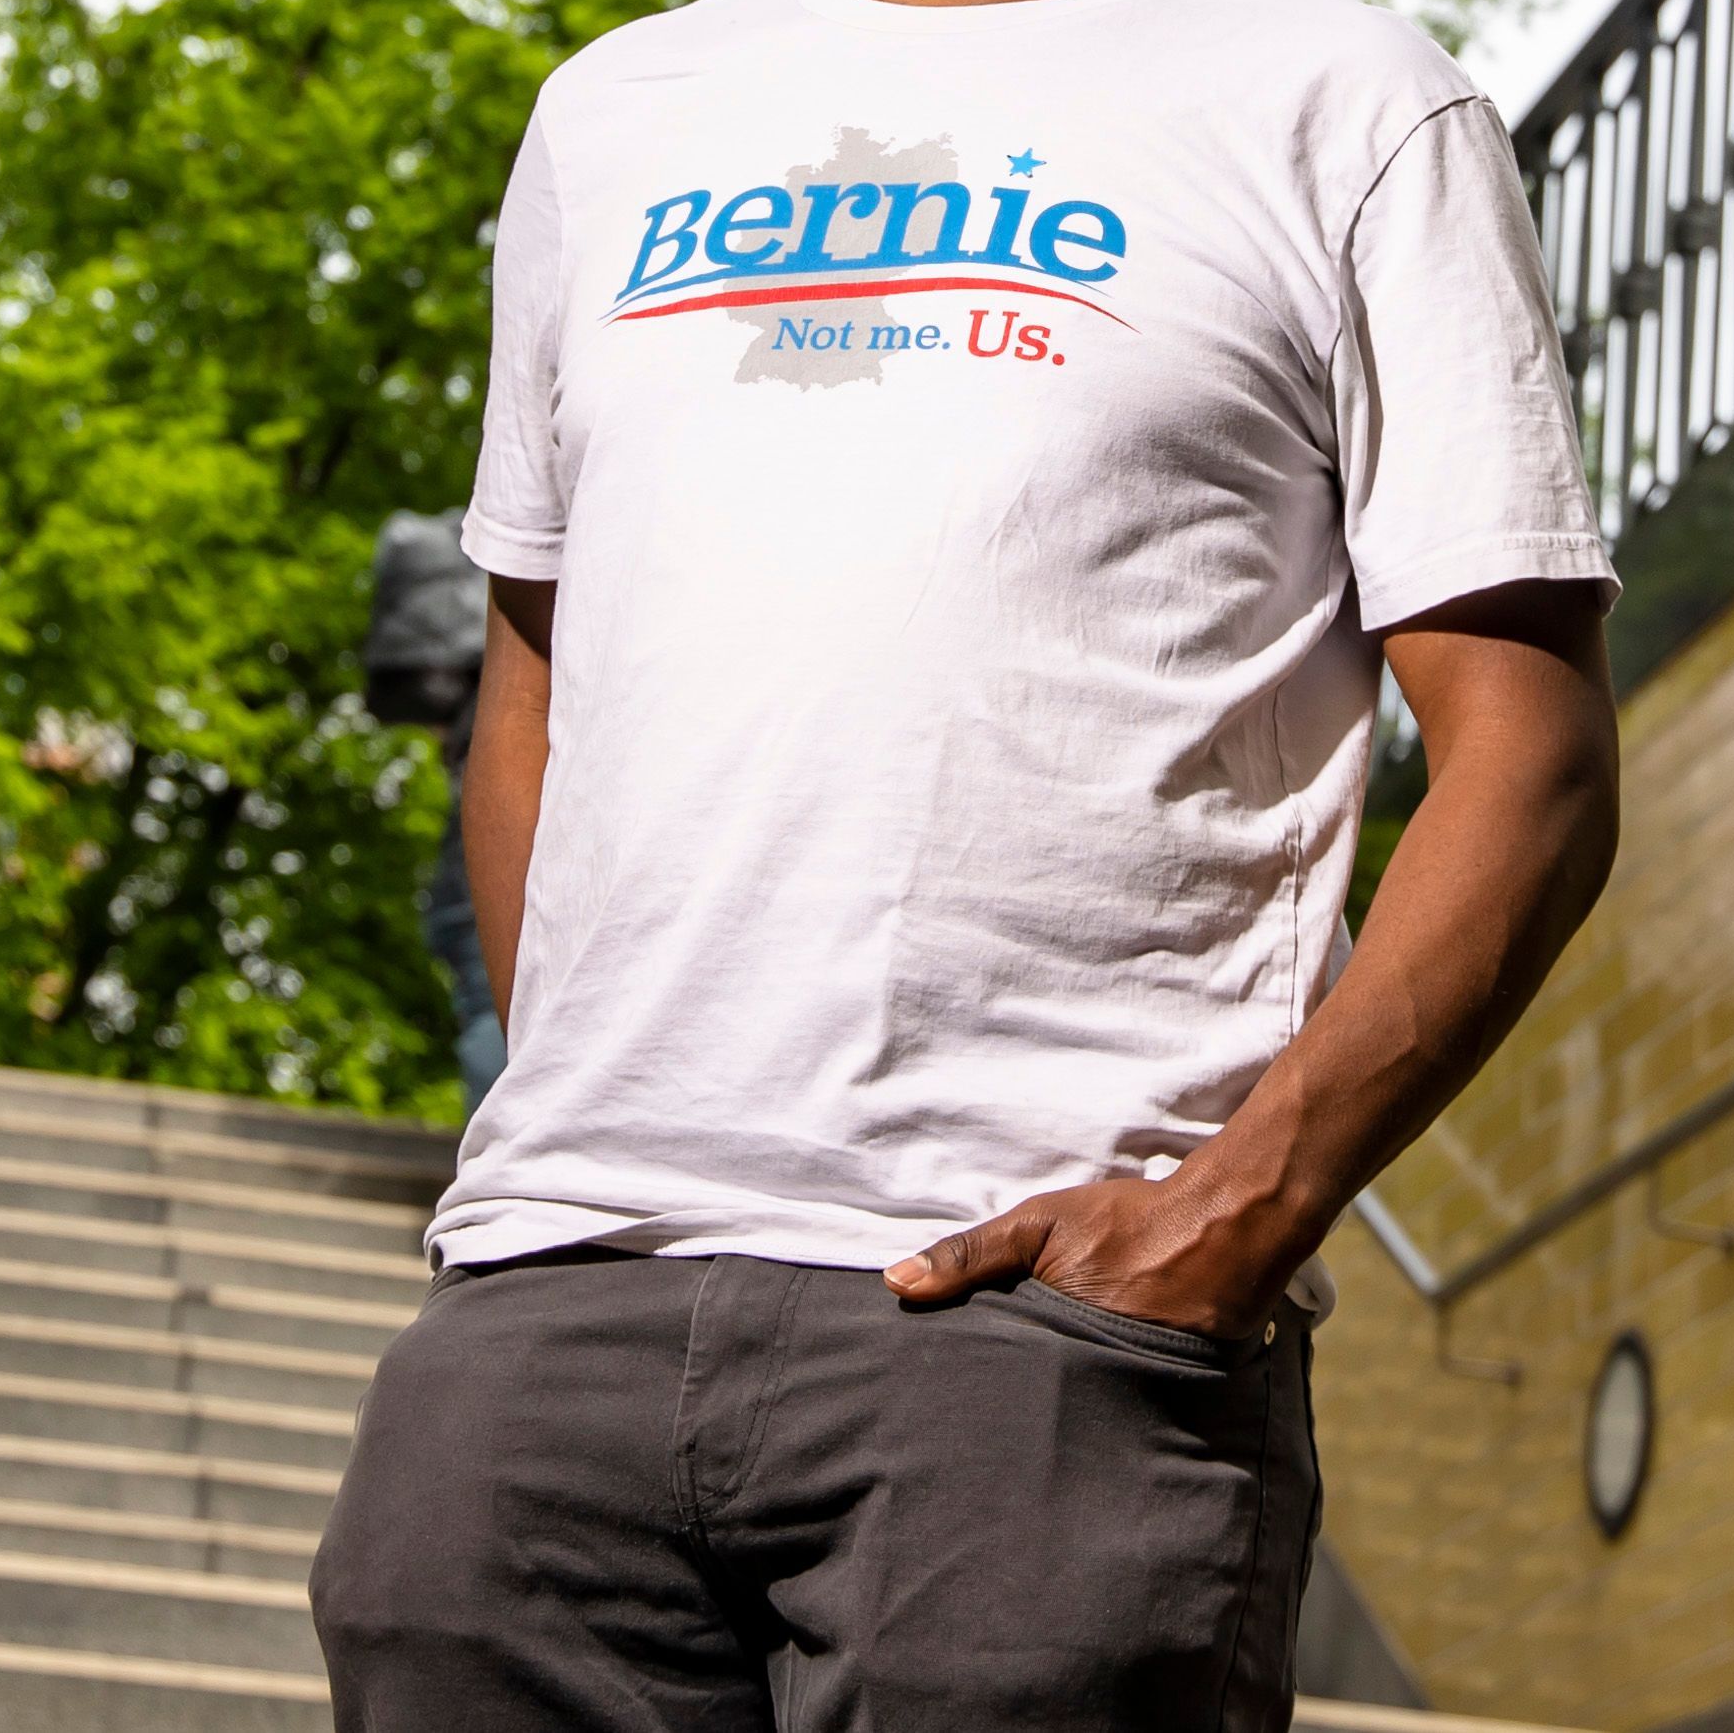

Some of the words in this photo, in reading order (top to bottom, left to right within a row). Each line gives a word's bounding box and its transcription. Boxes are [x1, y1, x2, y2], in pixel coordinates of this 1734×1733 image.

[614, 147, 1127, 302] Bernie
[770, 317, 855, 352] Not
[866, 324, 952, 352] me.
[967, 308, 1067, 367] Us.
